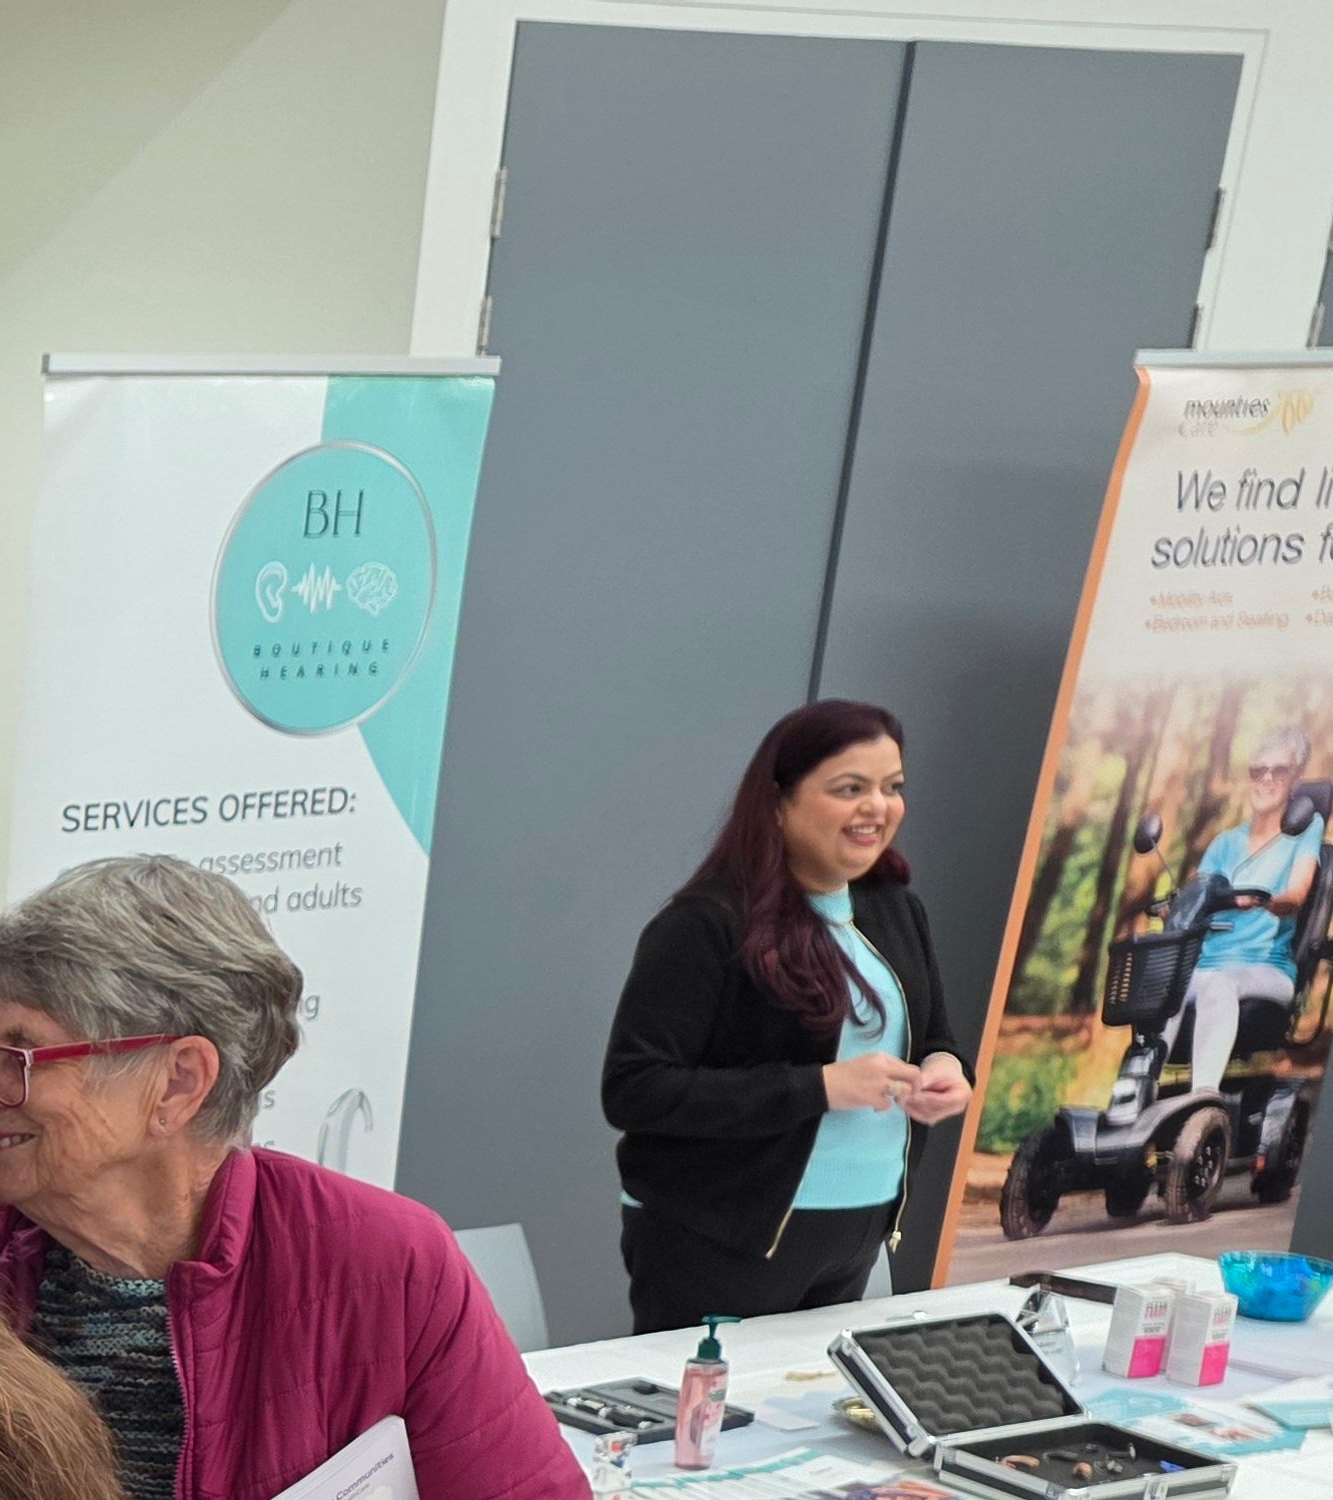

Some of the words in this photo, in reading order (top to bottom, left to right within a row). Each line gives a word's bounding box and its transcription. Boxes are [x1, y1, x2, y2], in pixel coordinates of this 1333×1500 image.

[1184, 396, 1270, 420] mounties
[1176, 468, 1227, 512] We
[1235, 467, 1306, 511] find
[303, 488, 365, 540] BH
[1151, 524, 1306, 569] solutions
[253, 638, 390, 659] BOUTIQUE
[260, 661, 379, 680] HEARING
[61, 795, 208, 833] SERVICES
[218, 786, 358, 823] OFFERED:
[199, 841, 344, 876] assessment
[251, 893, 279, 915] nd
[287, 881, 363, 912] adults
